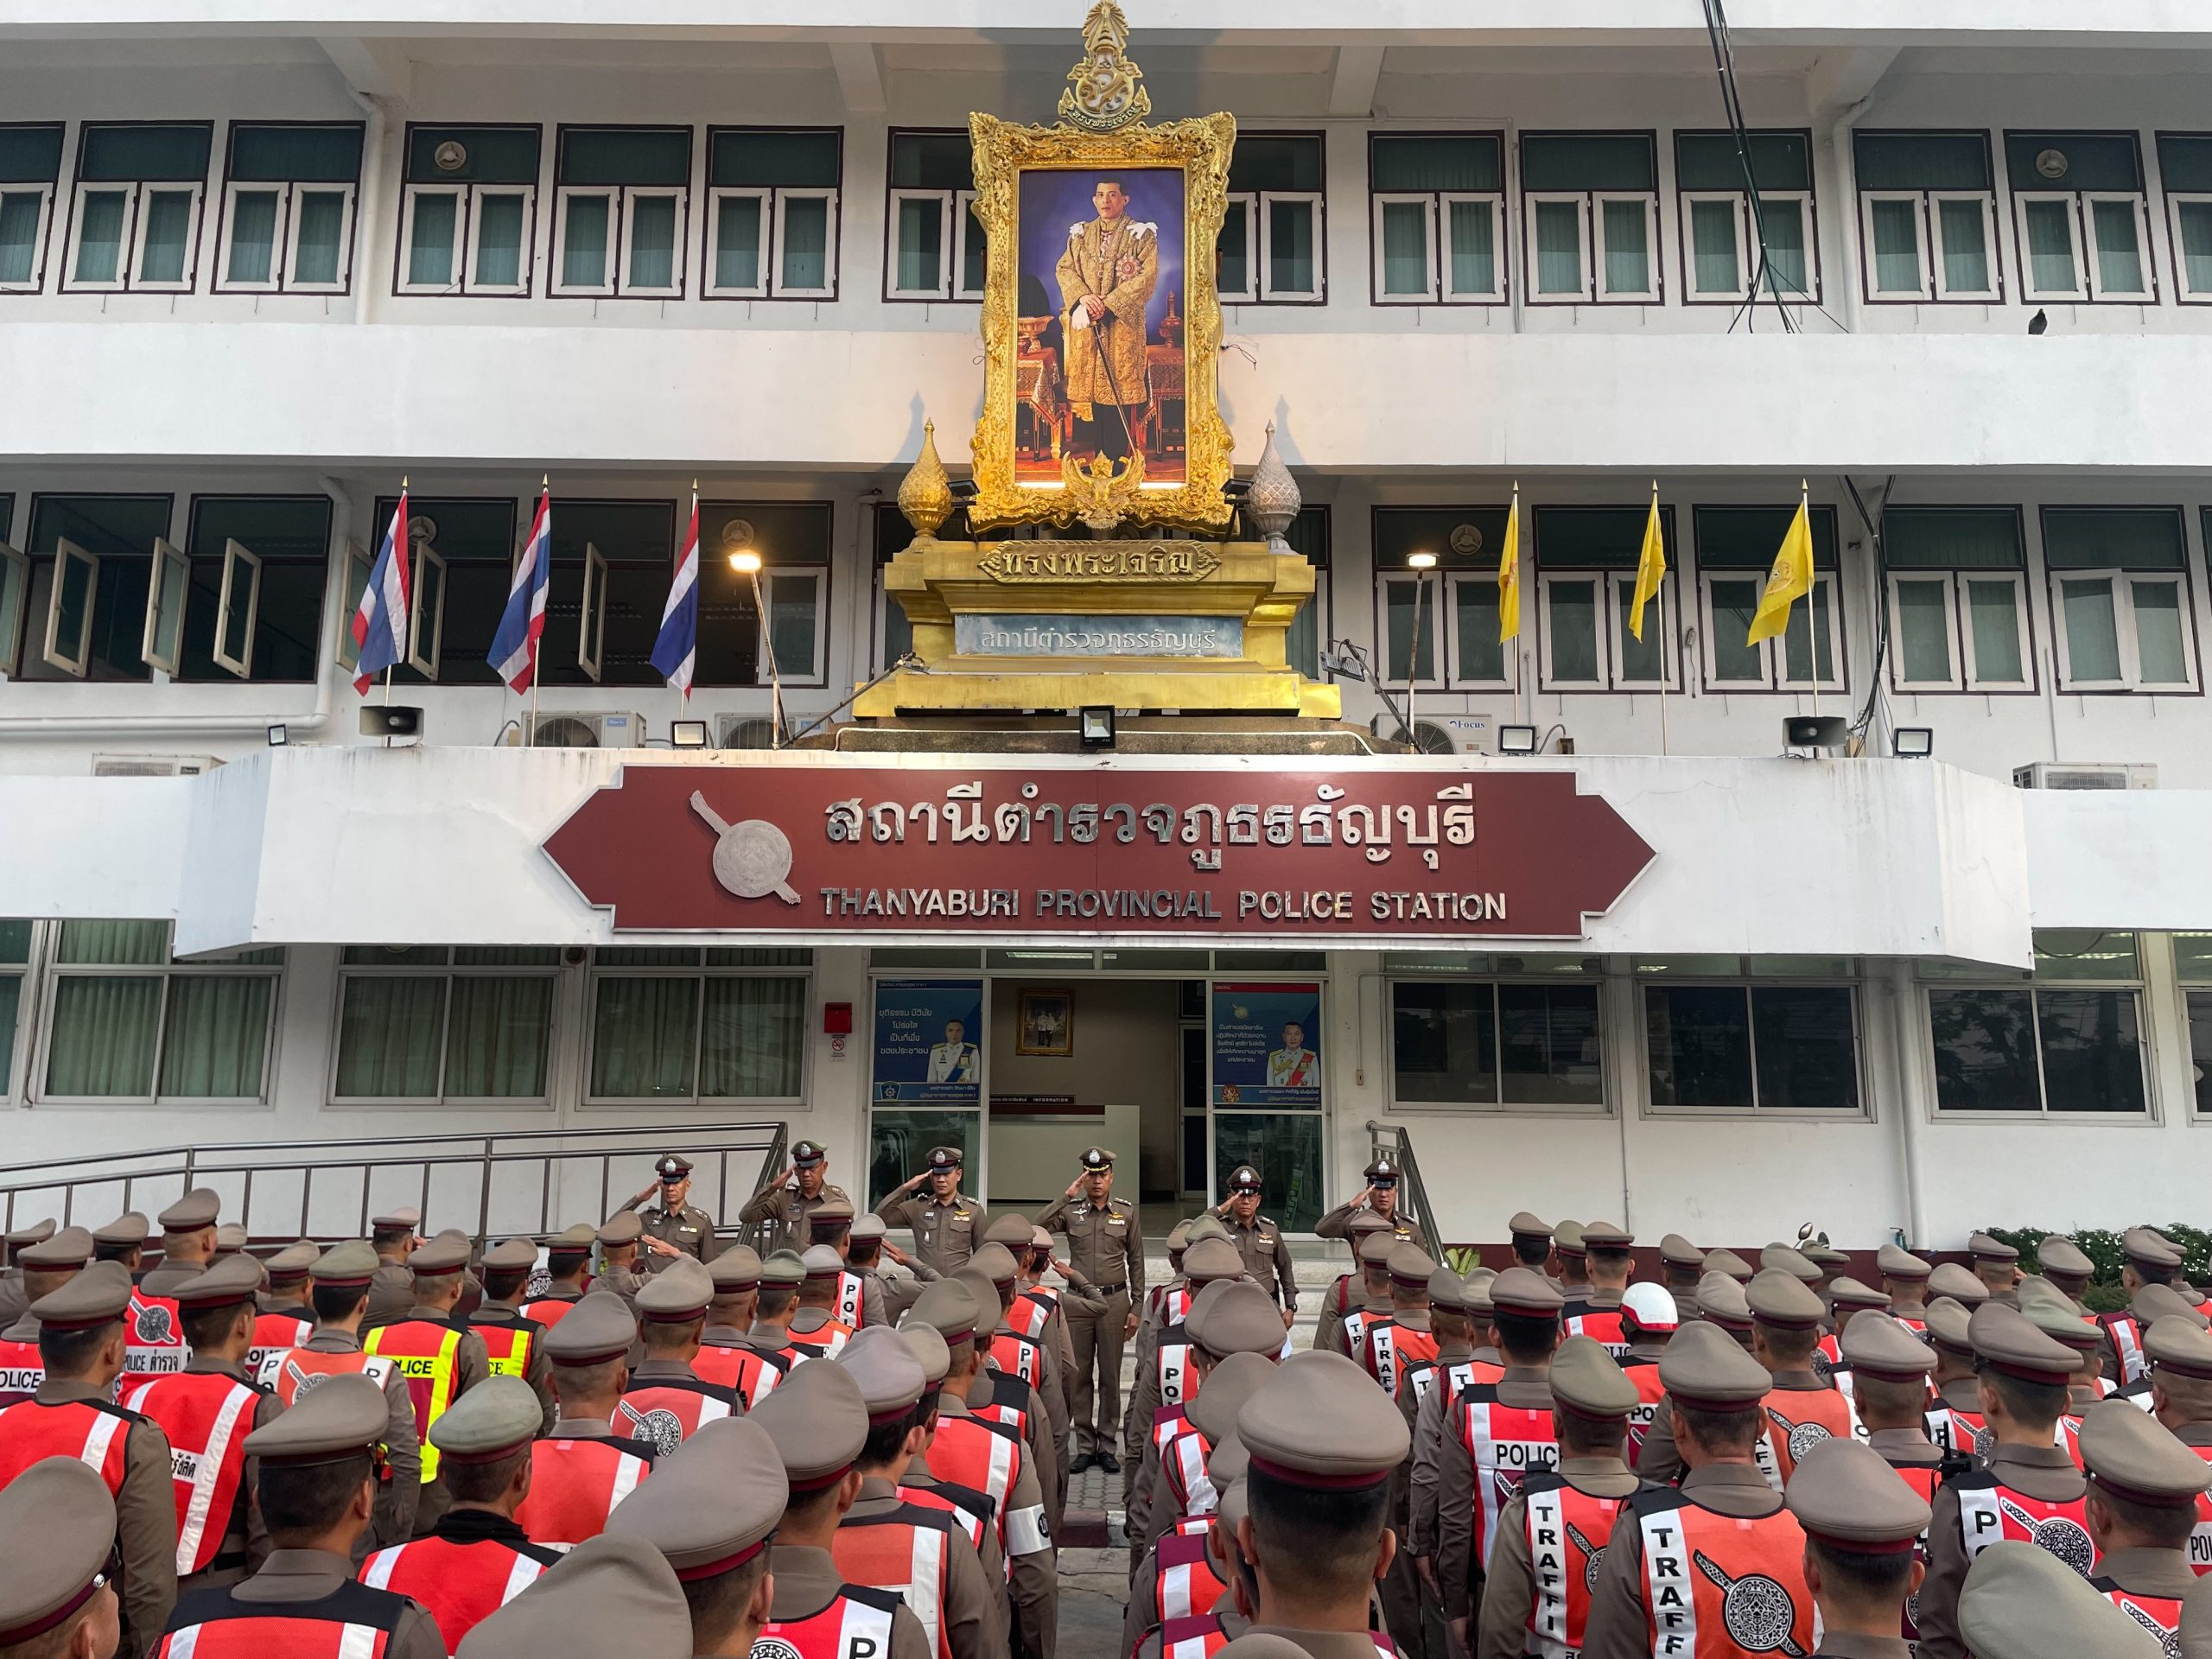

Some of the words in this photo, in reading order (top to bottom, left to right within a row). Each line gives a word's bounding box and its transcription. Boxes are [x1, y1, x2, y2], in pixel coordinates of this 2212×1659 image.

[1002, 545, 1193, 576] ทรงพระเจริญ
[981, 626, 1217, 655] สถานีตำรวจภูธรธัญบุรี
[1458, 720, 1484, 729] Focus
[824, 781, 1475, 870] สถานีตำรวจภูธรธัญบุรี
[821, 887, 1019, 917] THANYABURI
[1036, 888, 1223, 918] PROVINCIAL
[1240, 890, 1353, 919] POLICE
[1370, 891, 1506, 920] STATION
[880, 1046, 929, 1055] ของประชาชน
[149, 1349, 178, 1371] ตำรวจ
